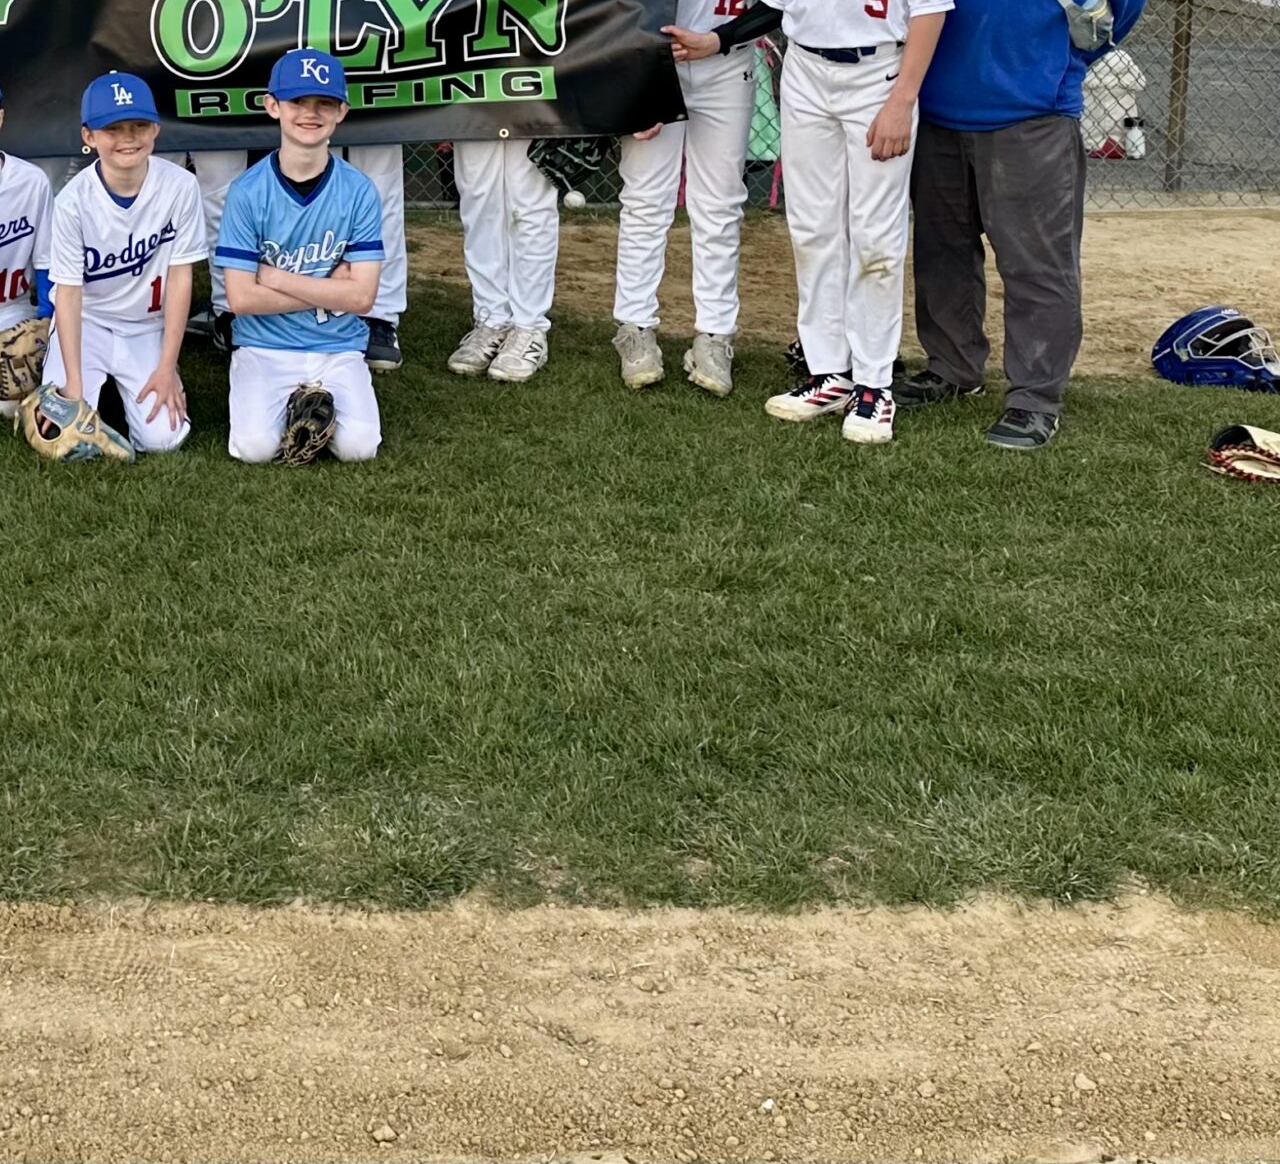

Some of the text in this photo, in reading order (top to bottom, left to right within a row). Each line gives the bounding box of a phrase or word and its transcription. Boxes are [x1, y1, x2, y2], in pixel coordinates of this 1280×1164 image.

[300, 58, 330, 84] KC
[113, 82, 133, 106] LA
[260, 230, 348, 274] Royals
